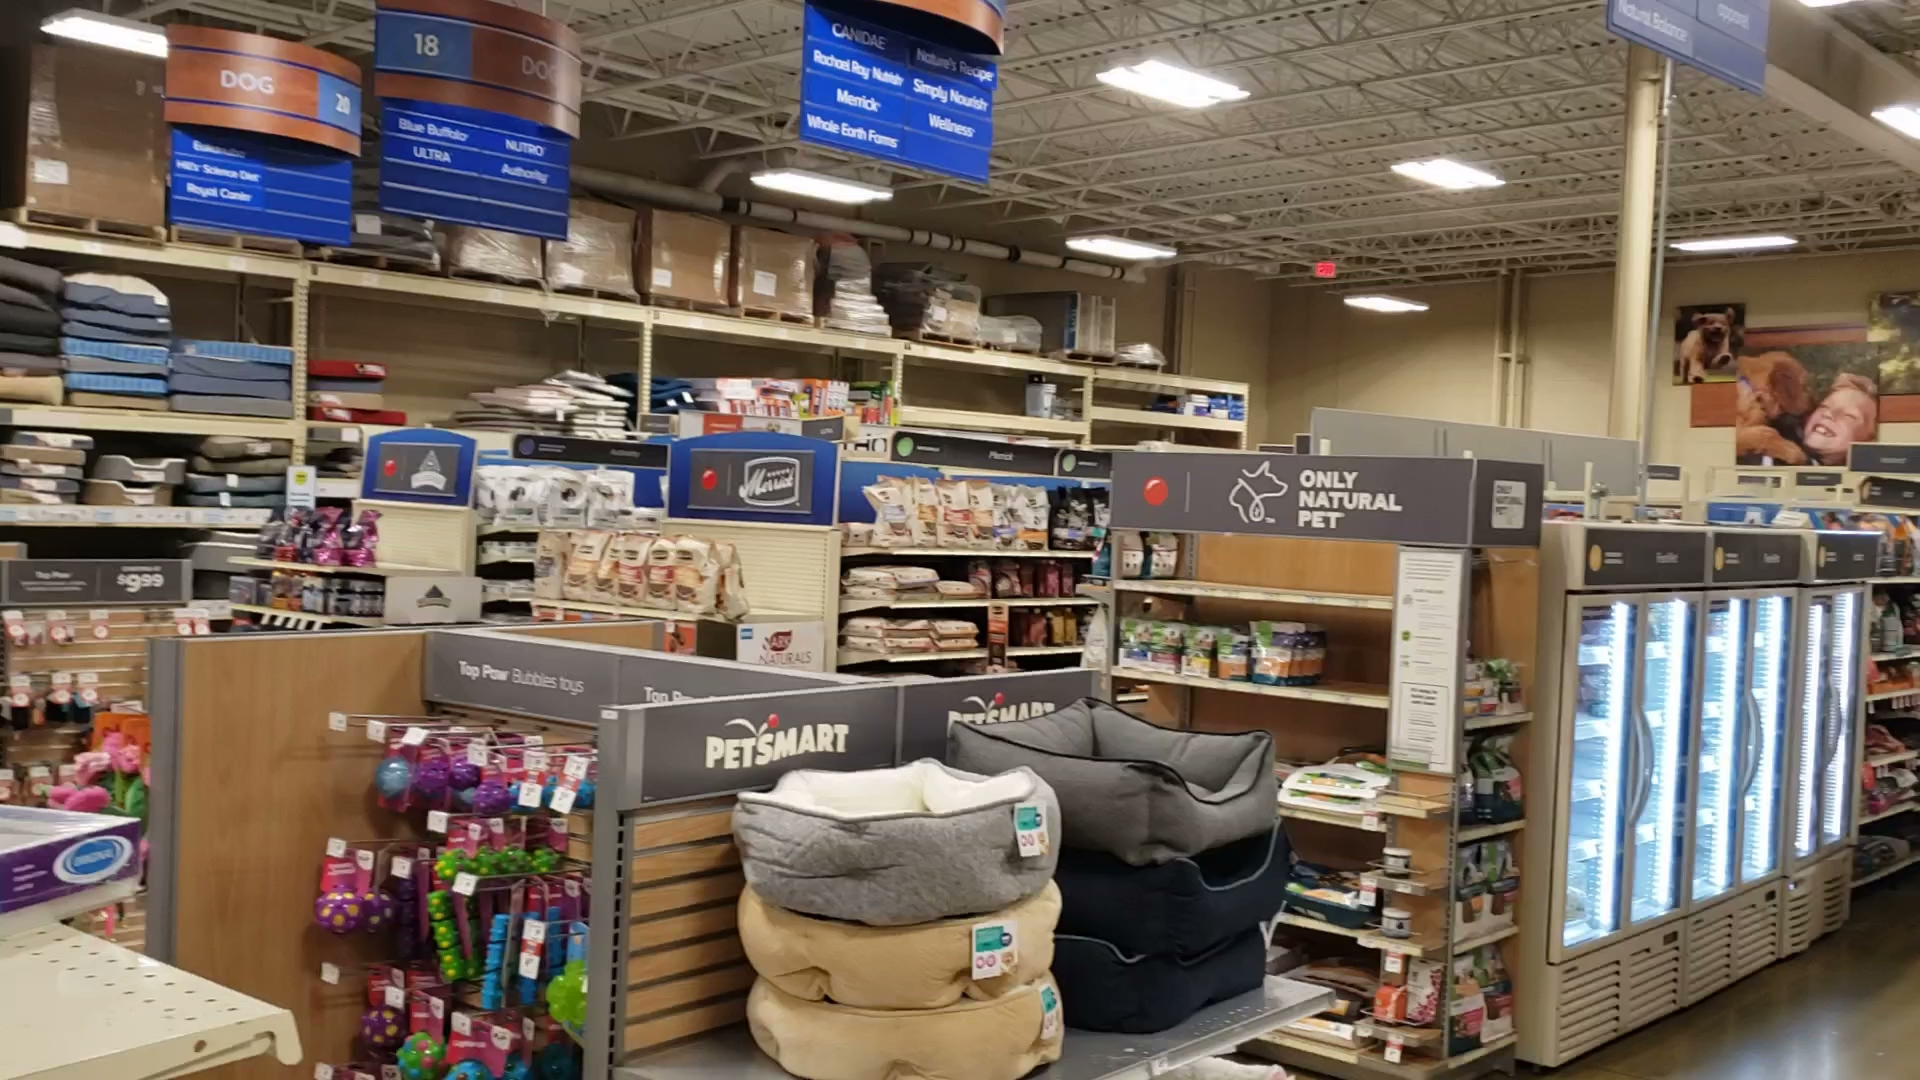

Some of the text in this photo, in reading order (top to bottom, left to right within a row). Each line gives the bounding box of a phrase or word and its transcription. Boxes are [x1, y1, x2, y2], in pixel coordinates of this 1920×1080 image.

[413, 33, 440, 57] 18
[832, 23, 887, 50] CANIDAE
[813, 50, 850, 72] Rachael
[851, 61, 870, 80] Ray
[916, 48, 995, 82] Nature's Recipe
[220, 69, 275, 95] DOG
[836, 88, 880, 112] Merrick
[913, 78, 988, 112] Simply Nourish
[399, 118, 469, 142] Blue Buffalo
[807, 113, 899, 149] Whole Earth Farms
[928, 113, 975, 138] Wellness
[413, 146, 452, 163] ULTRA
[505, 139, 545, 157] NUTRO
[501, 163, 549, 184] Authority
[186, 182, 218, 198] Royal
[1299, 469, 1359, 489] ONLY
[1298, 490, 1403, 512] NATURAL
[1298, 509, 1346, 529] PET
[458, 660, 585, 696] Top Paw Bubbles toys
[705, 723, 850, 770] PETSMART
